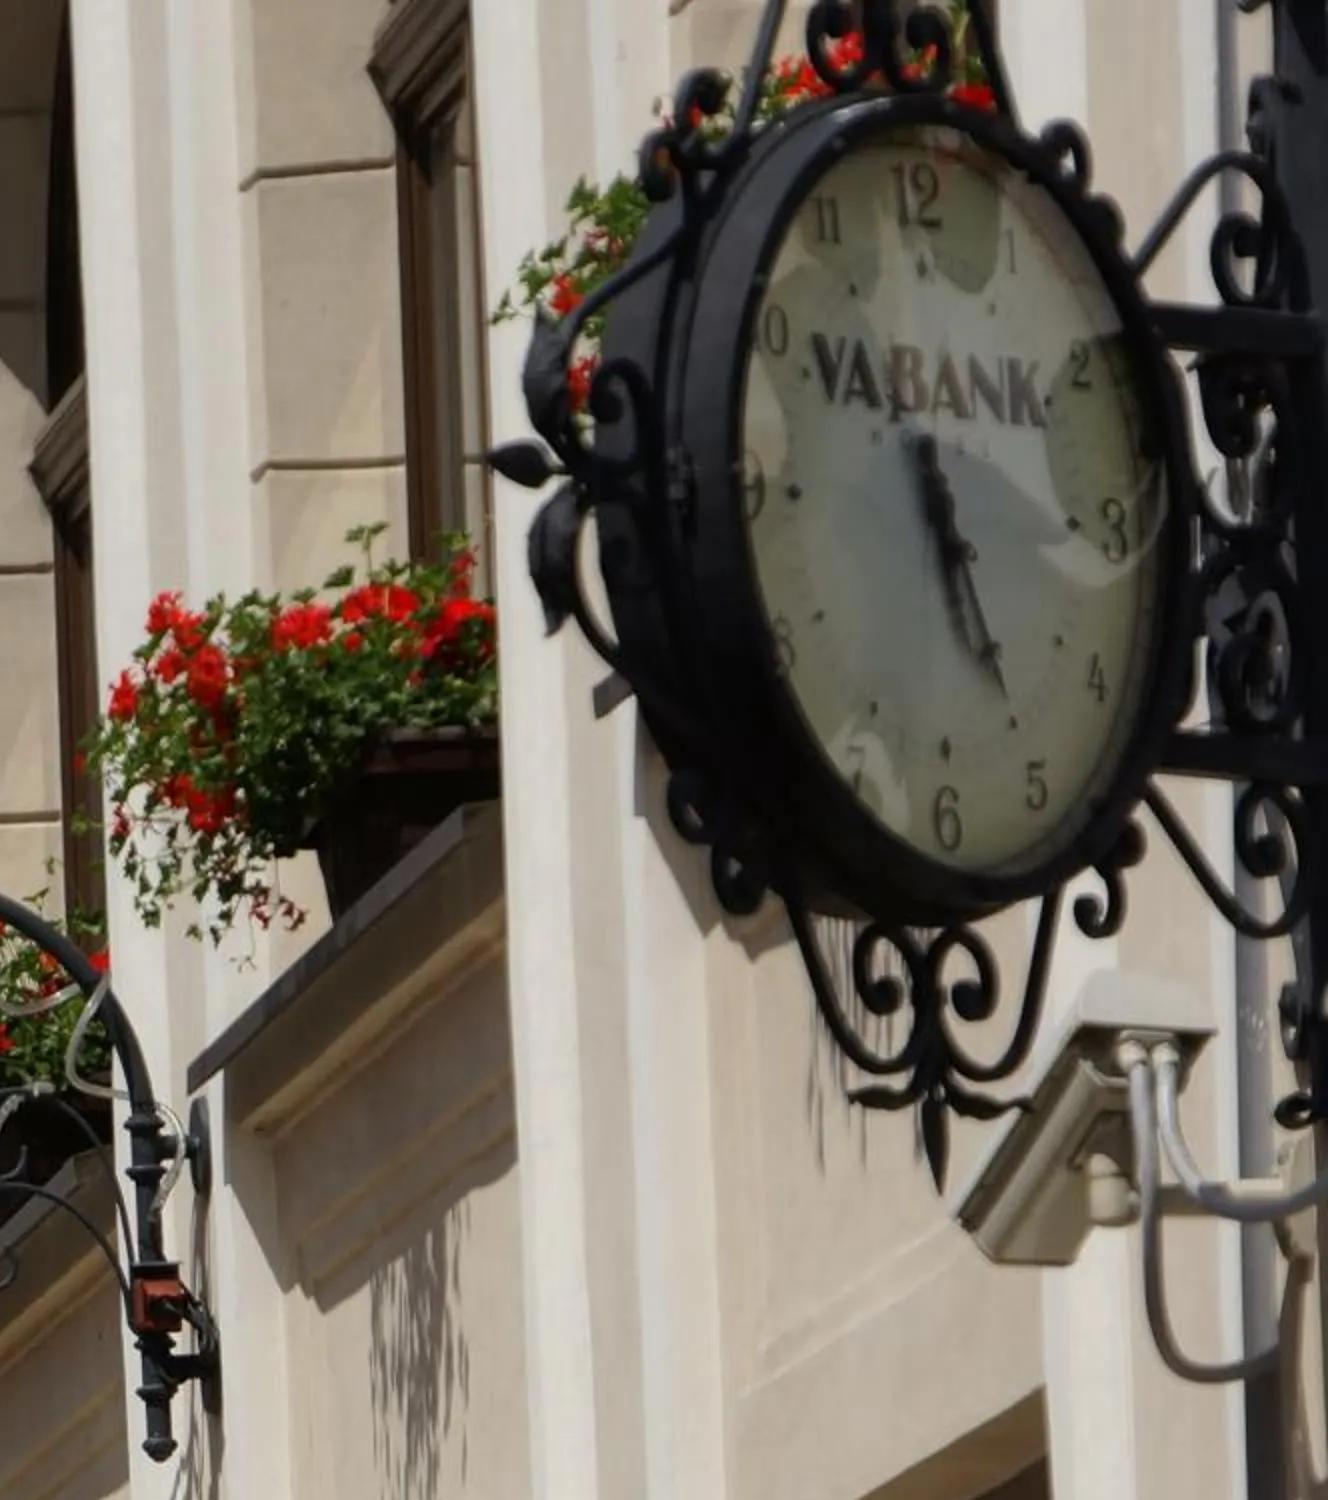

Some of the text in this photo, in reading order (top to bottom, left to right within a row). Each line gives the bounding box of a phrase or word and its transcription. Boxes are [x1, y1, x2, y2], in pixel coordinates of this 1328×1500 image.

[811, 196, 840, 243] 11
[889, 161, 943, 229] 12
[1005, 229, 1018, 275] 1
[758, 303, 789, 357] 0
[1069, 338, 1092, 390] 2
[1102, 498, 1128, 564] 3
[1087, 650, 1110, 702] 4
[1025, 757, 1049, 811] 5
[934, 784, 963, 852] 6
